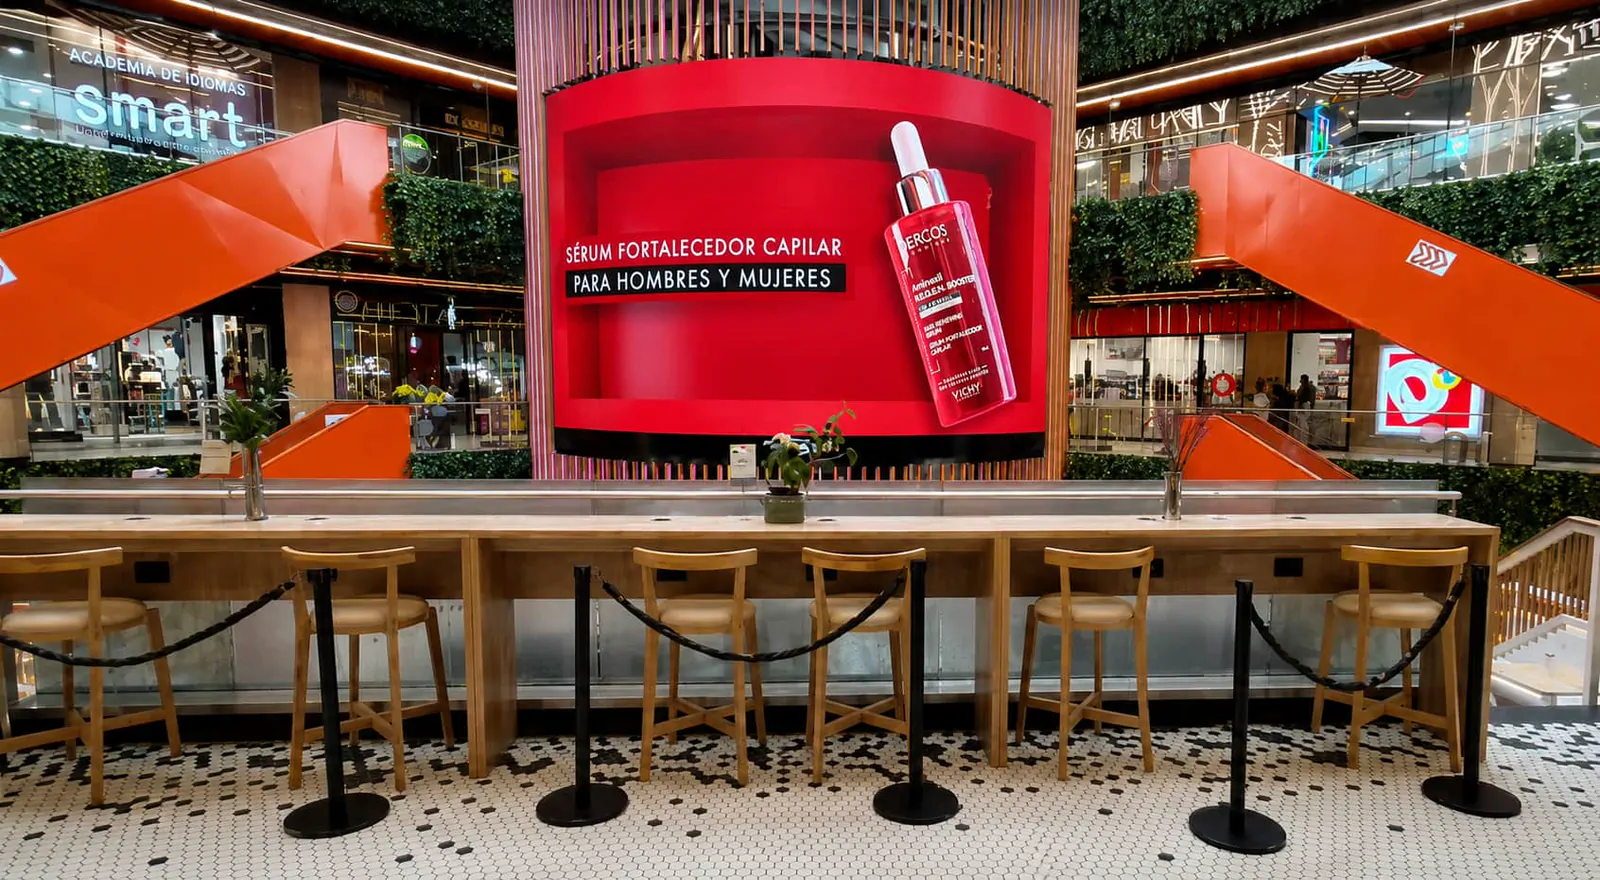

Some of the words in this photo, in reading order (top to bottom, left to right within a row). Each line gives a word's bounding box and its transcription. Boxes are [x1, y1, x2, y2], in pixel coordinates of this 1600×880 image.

[69, 48, 156, 78] ACADEMIA
[161, 67, 182, 83] DE
[185, 72, 246, 97] IDIOMAS
[74, 84, 247, 148] smart
[565, 241, 613, 264] SÉRUM
[618, 237, 756, 260] FORTALECEDOR
[762, 237, 842, 257] CAPILAR
[573, 273, 611, 294] PARA
[617, 268, 711, 291] HOMBRES
[718, 268, 731, 288] Y
[738, 268, 832, 289] MUJERES
[951, 381, 980, 400] VICHY
